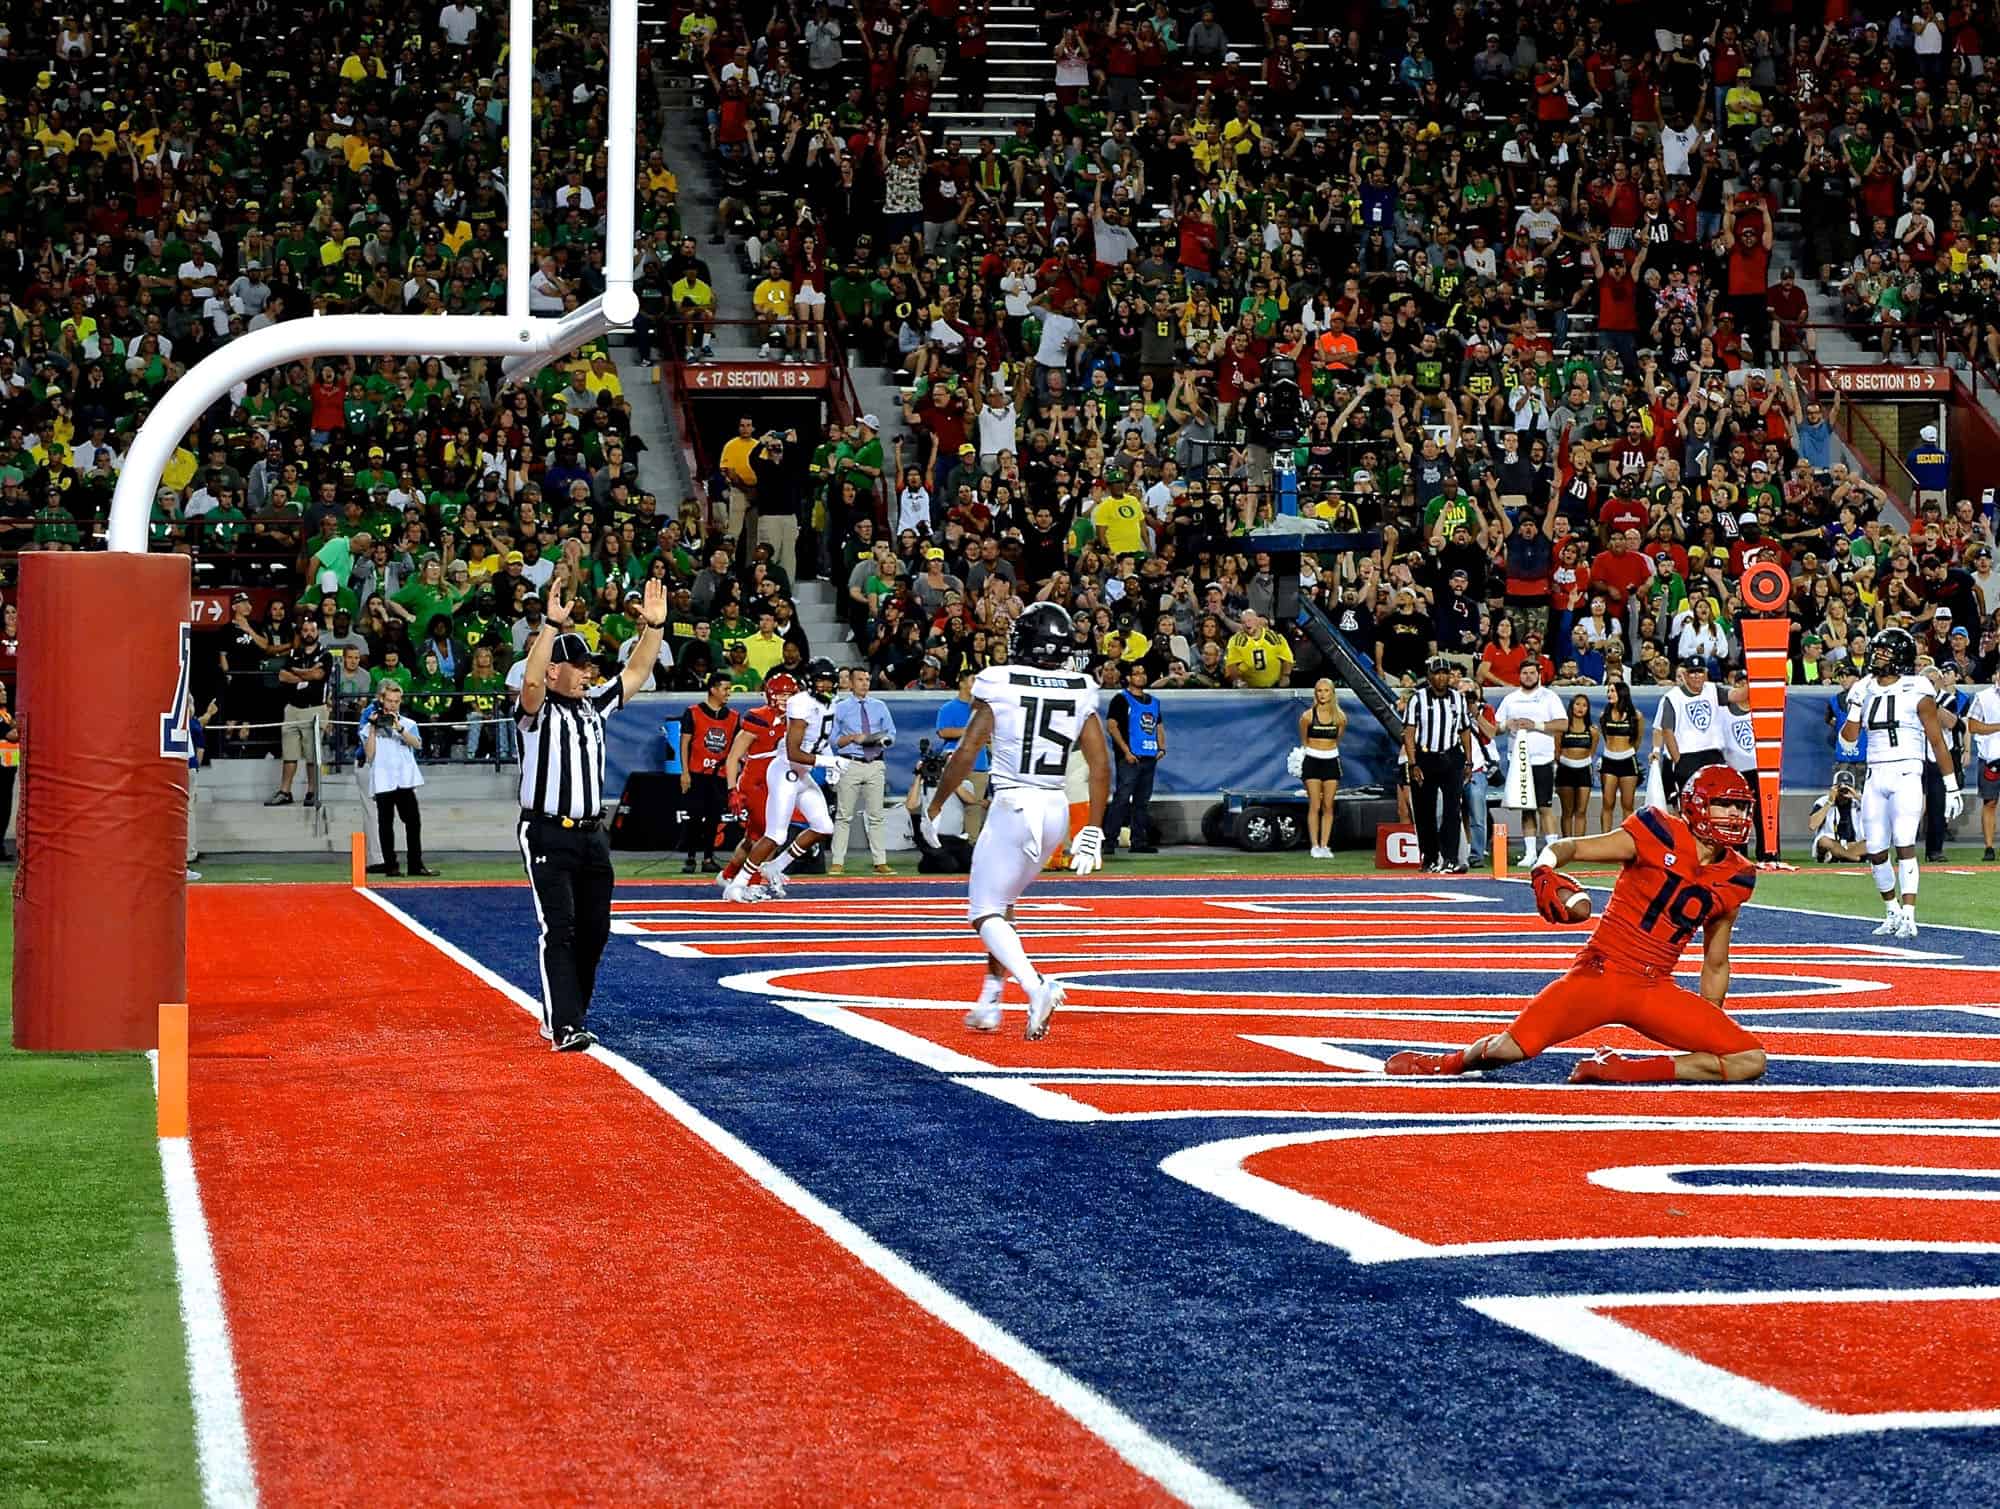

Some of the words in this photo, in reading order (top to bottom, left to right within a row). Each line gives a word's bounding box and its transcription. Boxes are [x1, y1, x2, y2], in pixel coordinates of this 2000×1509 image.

[1157, 321, 1168, 336] 6
[712, 372, 723, 387] 17
[727, 372, 778, 386] SECTION
[783, 372, 795, 386] 18
[1839, 375, 1852, 389] 18
[1856, 374, 1904, 389] SECTION
[1908, 374, 1920, 389] 19
[1916, 454, 1945, 464] SECURITY
[1696, 717, 1707, 726] 12
[1868, 695, 1899, 747] 4
[1019, 696, 1077, 776] 15
[1742, 736, 1752, 746] 12
[1519, 741, 1528, 806] OREGON
[1386, 832, 1421, 864] G
[1641, 869, 1714, 944] 19
